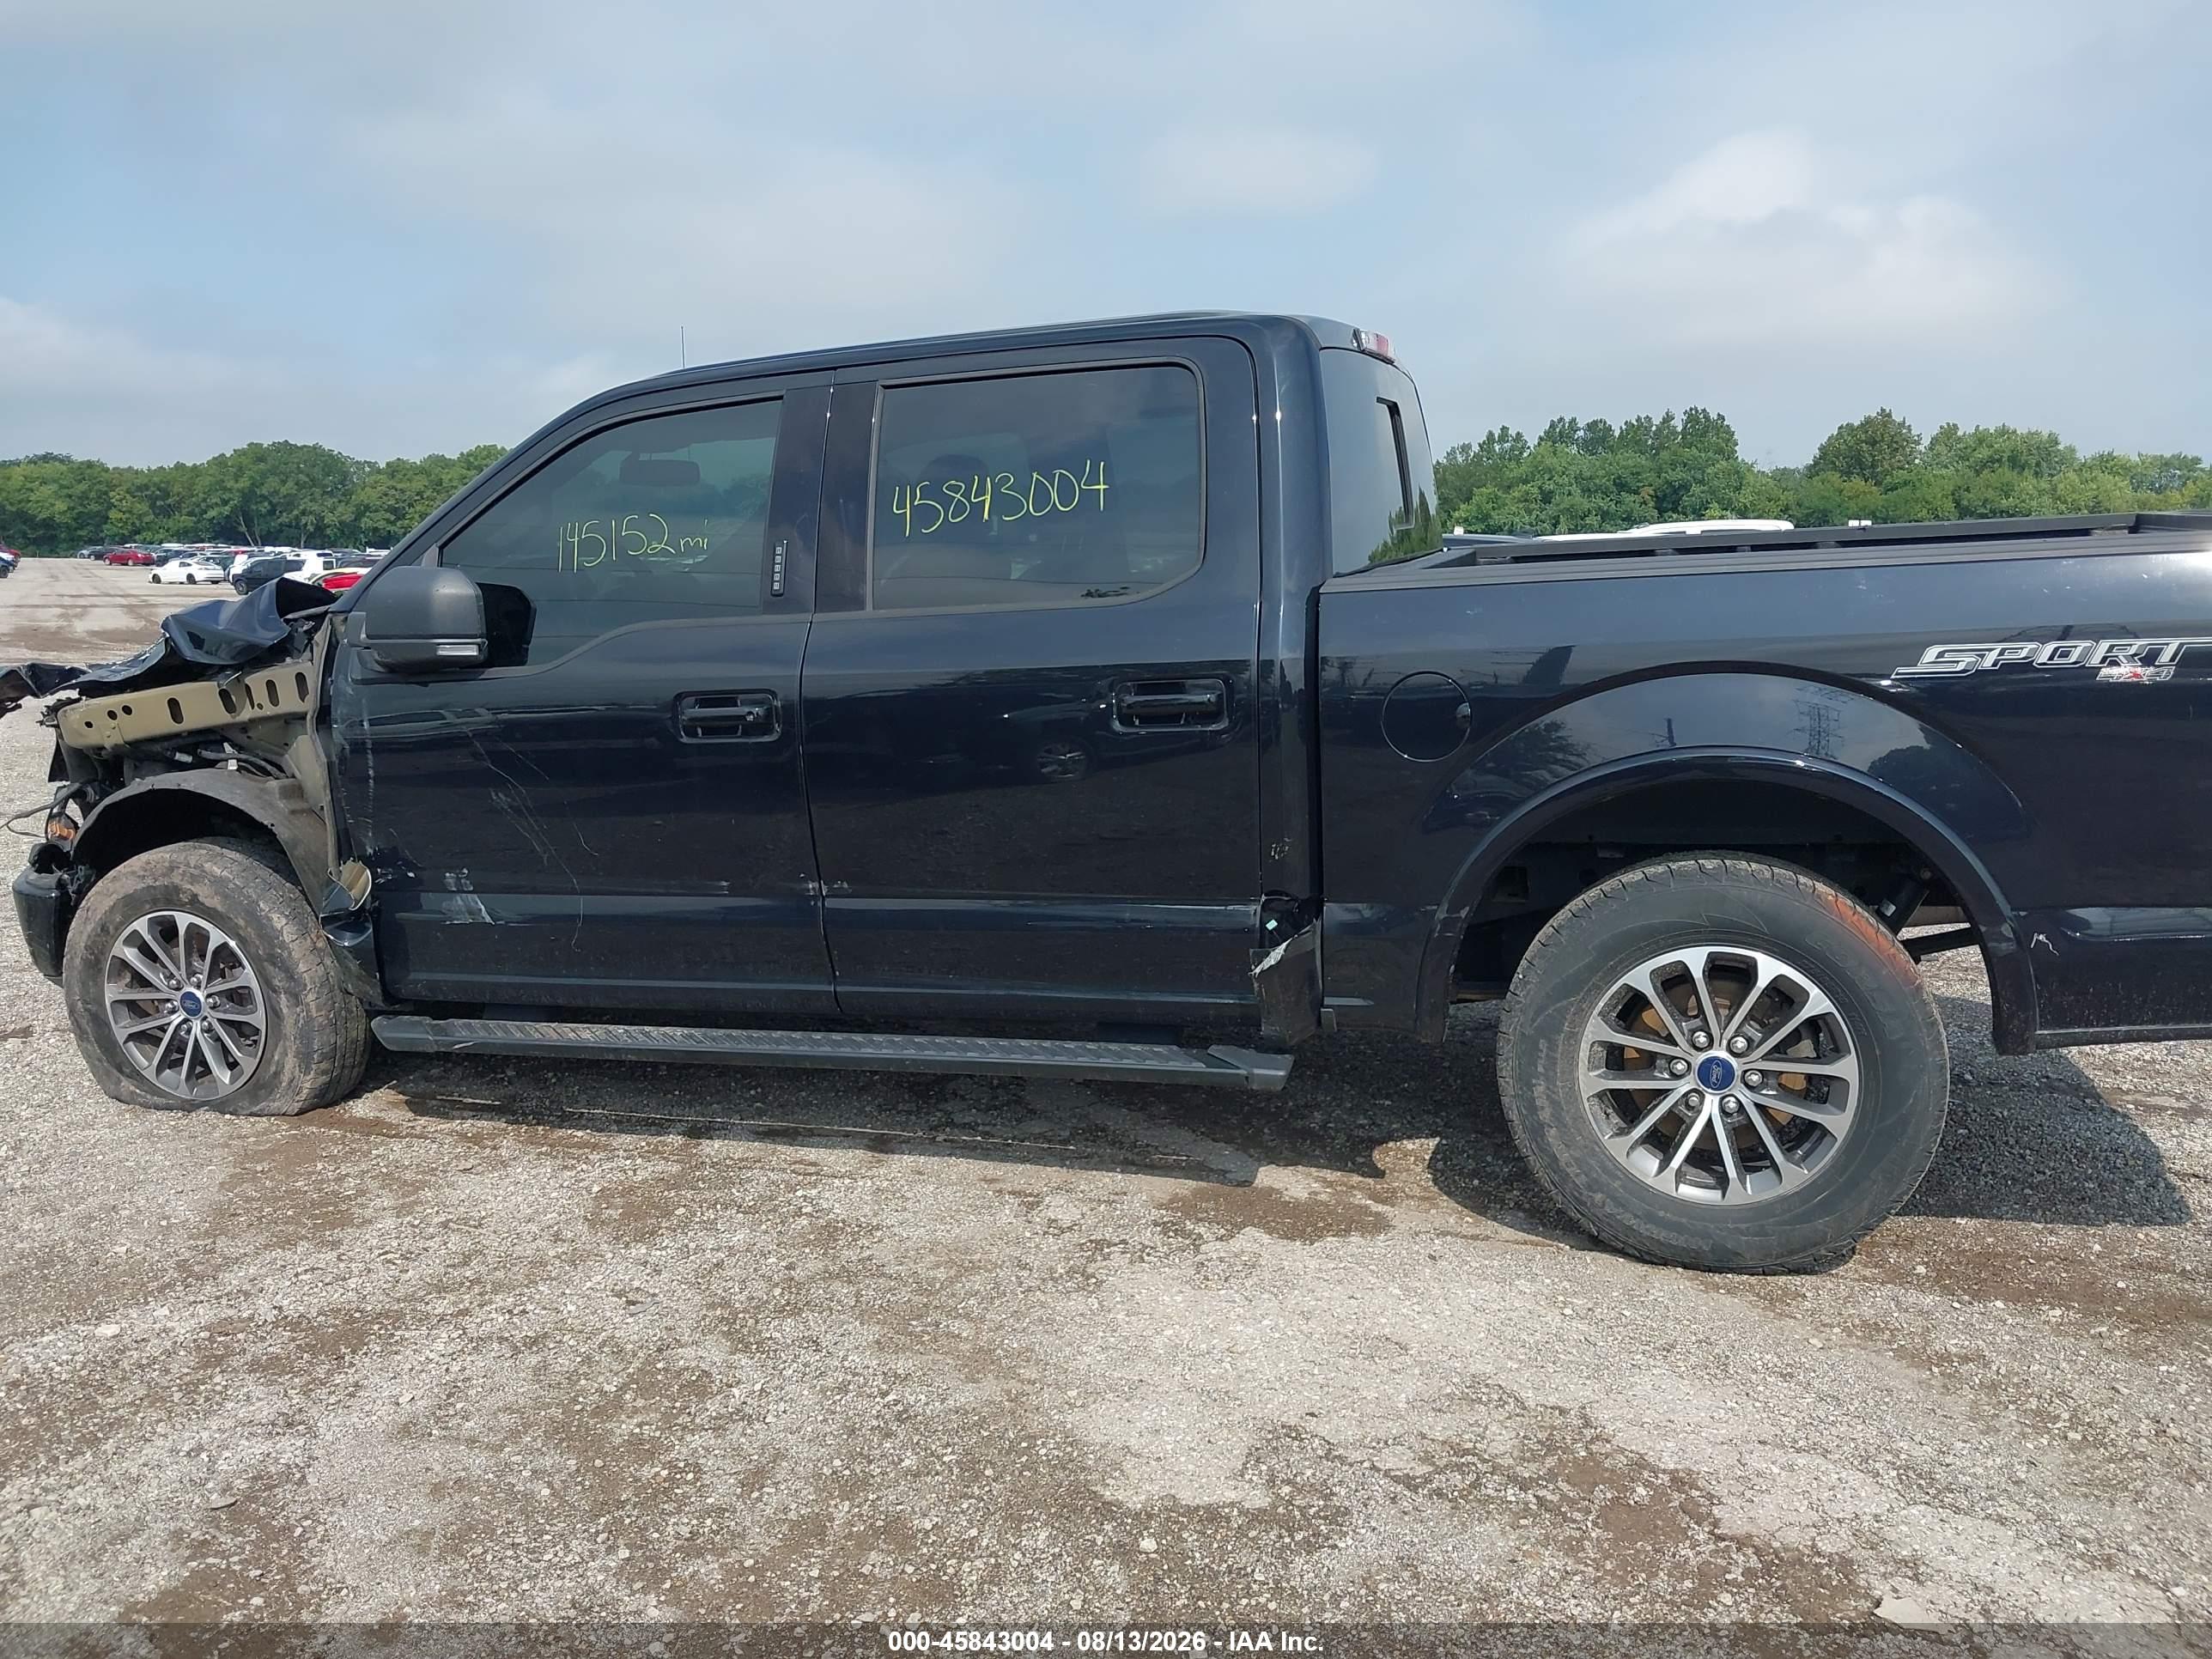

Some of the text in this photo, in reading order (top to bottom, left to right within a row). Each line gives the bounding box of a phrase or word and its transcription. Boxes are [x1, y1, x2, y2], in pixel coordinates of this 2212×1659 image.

[893, 459, 1109, 537] 45843004
[558, 514, 708, 573] 145152 mi
[1890, 636, 2212, 678] SPORT
